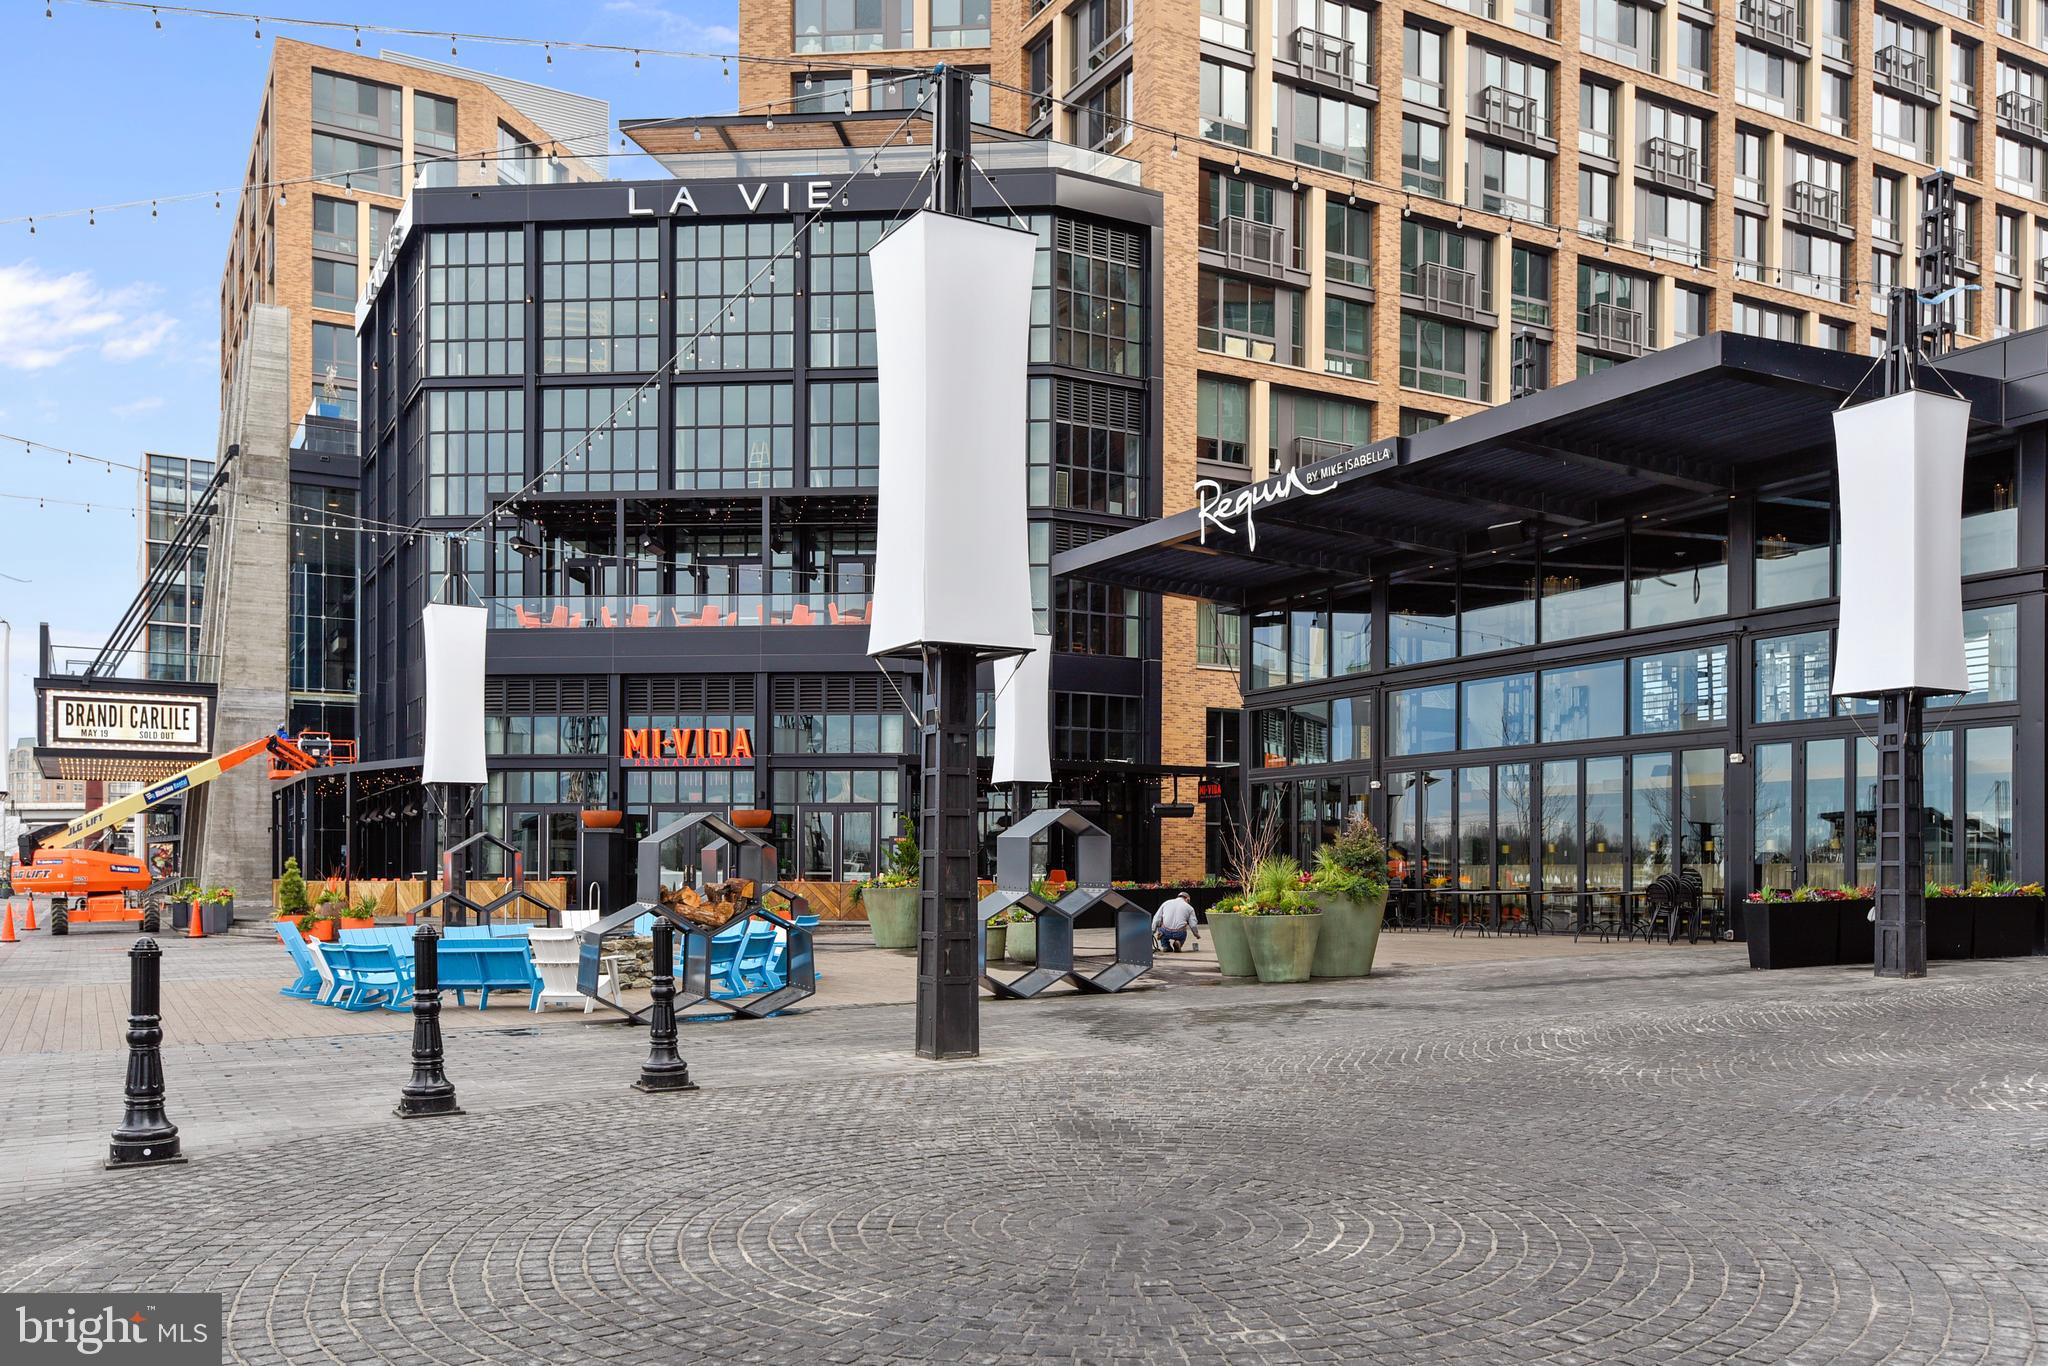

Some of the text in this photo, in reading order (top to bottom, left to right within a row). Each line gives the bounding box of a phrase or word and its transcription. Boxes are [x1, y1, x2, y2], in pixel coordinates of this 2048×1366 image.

[628, 181, 833, 216] LA VIE
[1320, 462, 1343, 479] MIKE
[1344, 448, 1390, 471] ISABELLA
[1194, 459, 1339, 552] Requin
[65, 703, 190, 731] BRANDI CARLILE
[80, 728, 109, 738] MAY 19
[139, 731, 175, 740] SOLD OUT
[671, 728, 753, 759] VIDA
[634, 758, 742, 767] RESTAURANTE
[68, 813, 104, 837] JLG LIFT
[25, 869, 51, 880] LIFT
